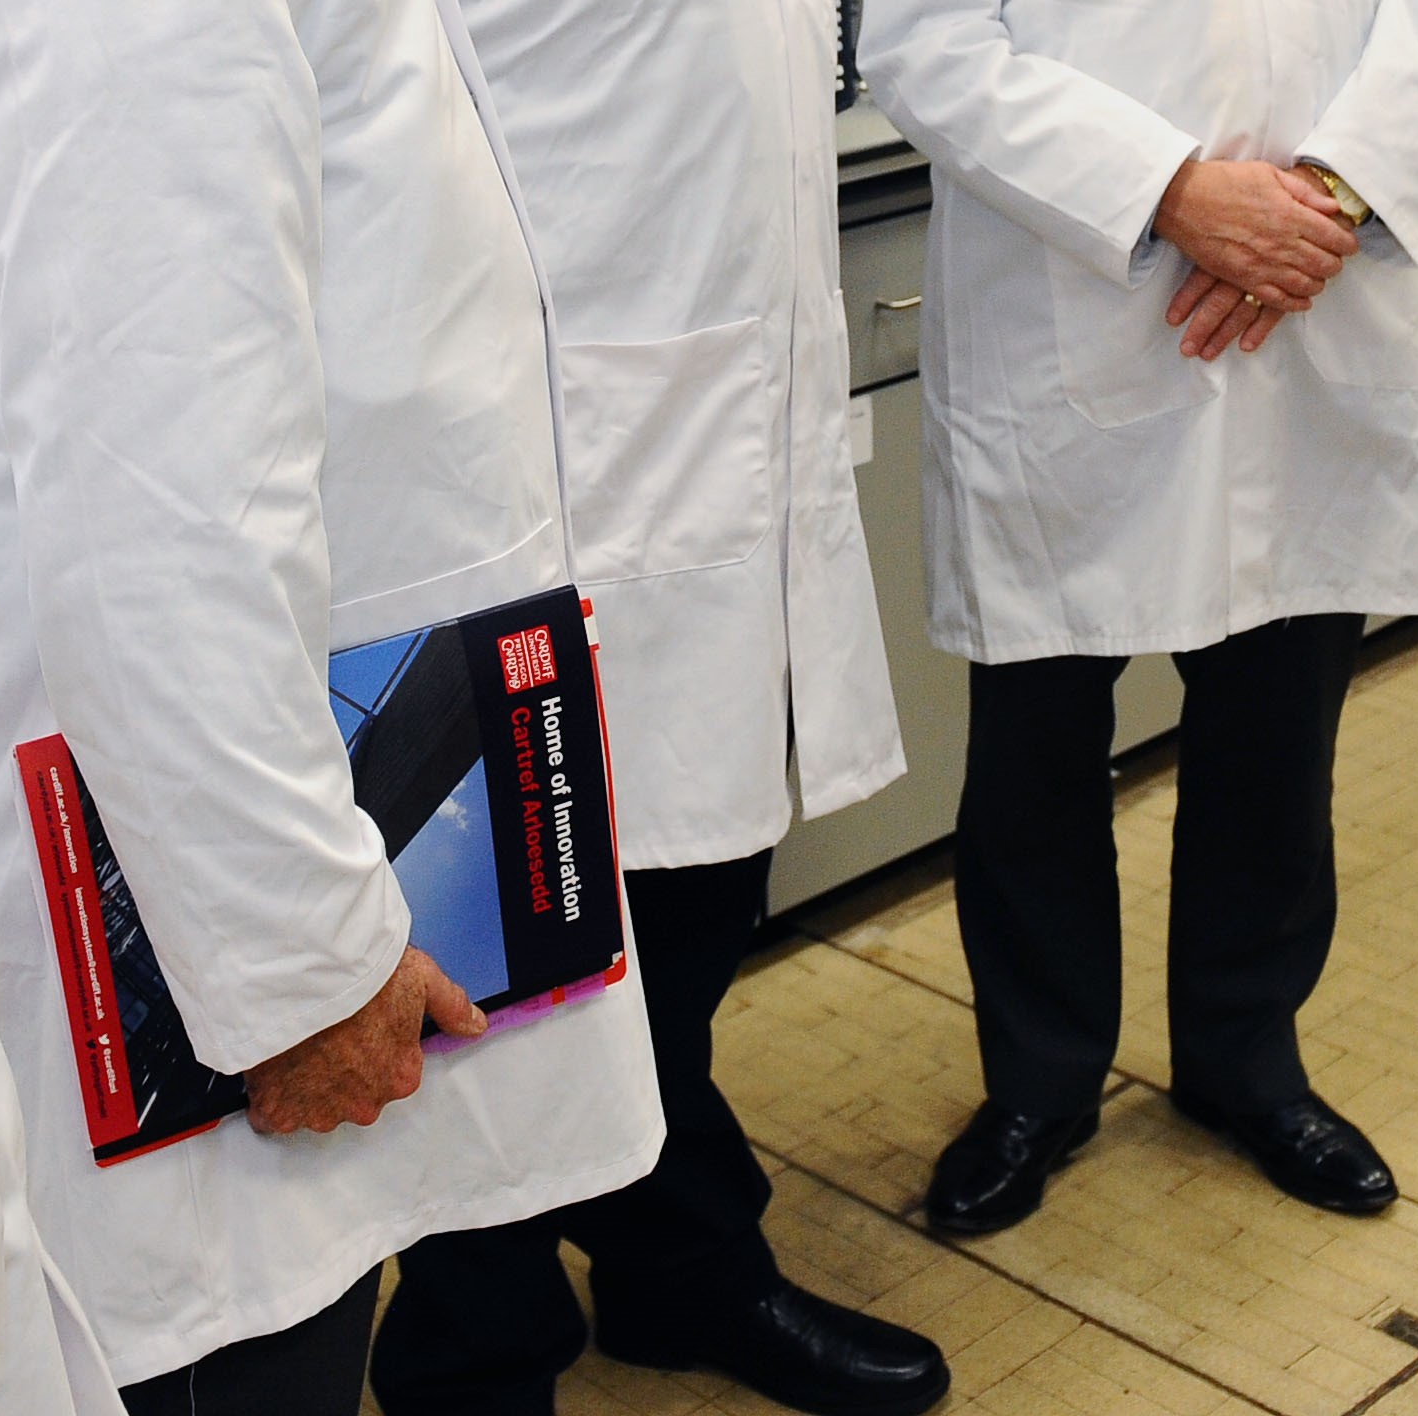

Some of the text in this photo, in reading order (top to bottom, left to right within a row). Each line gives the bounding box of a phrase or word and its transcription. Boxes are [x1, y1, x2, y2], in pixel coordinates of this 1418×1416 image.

[534, 629, 555, 679] CARDIFF
[510, 705, 552, 914] Cartref Arloesedd
[541, 696, 582, 922] Home of Innovation
